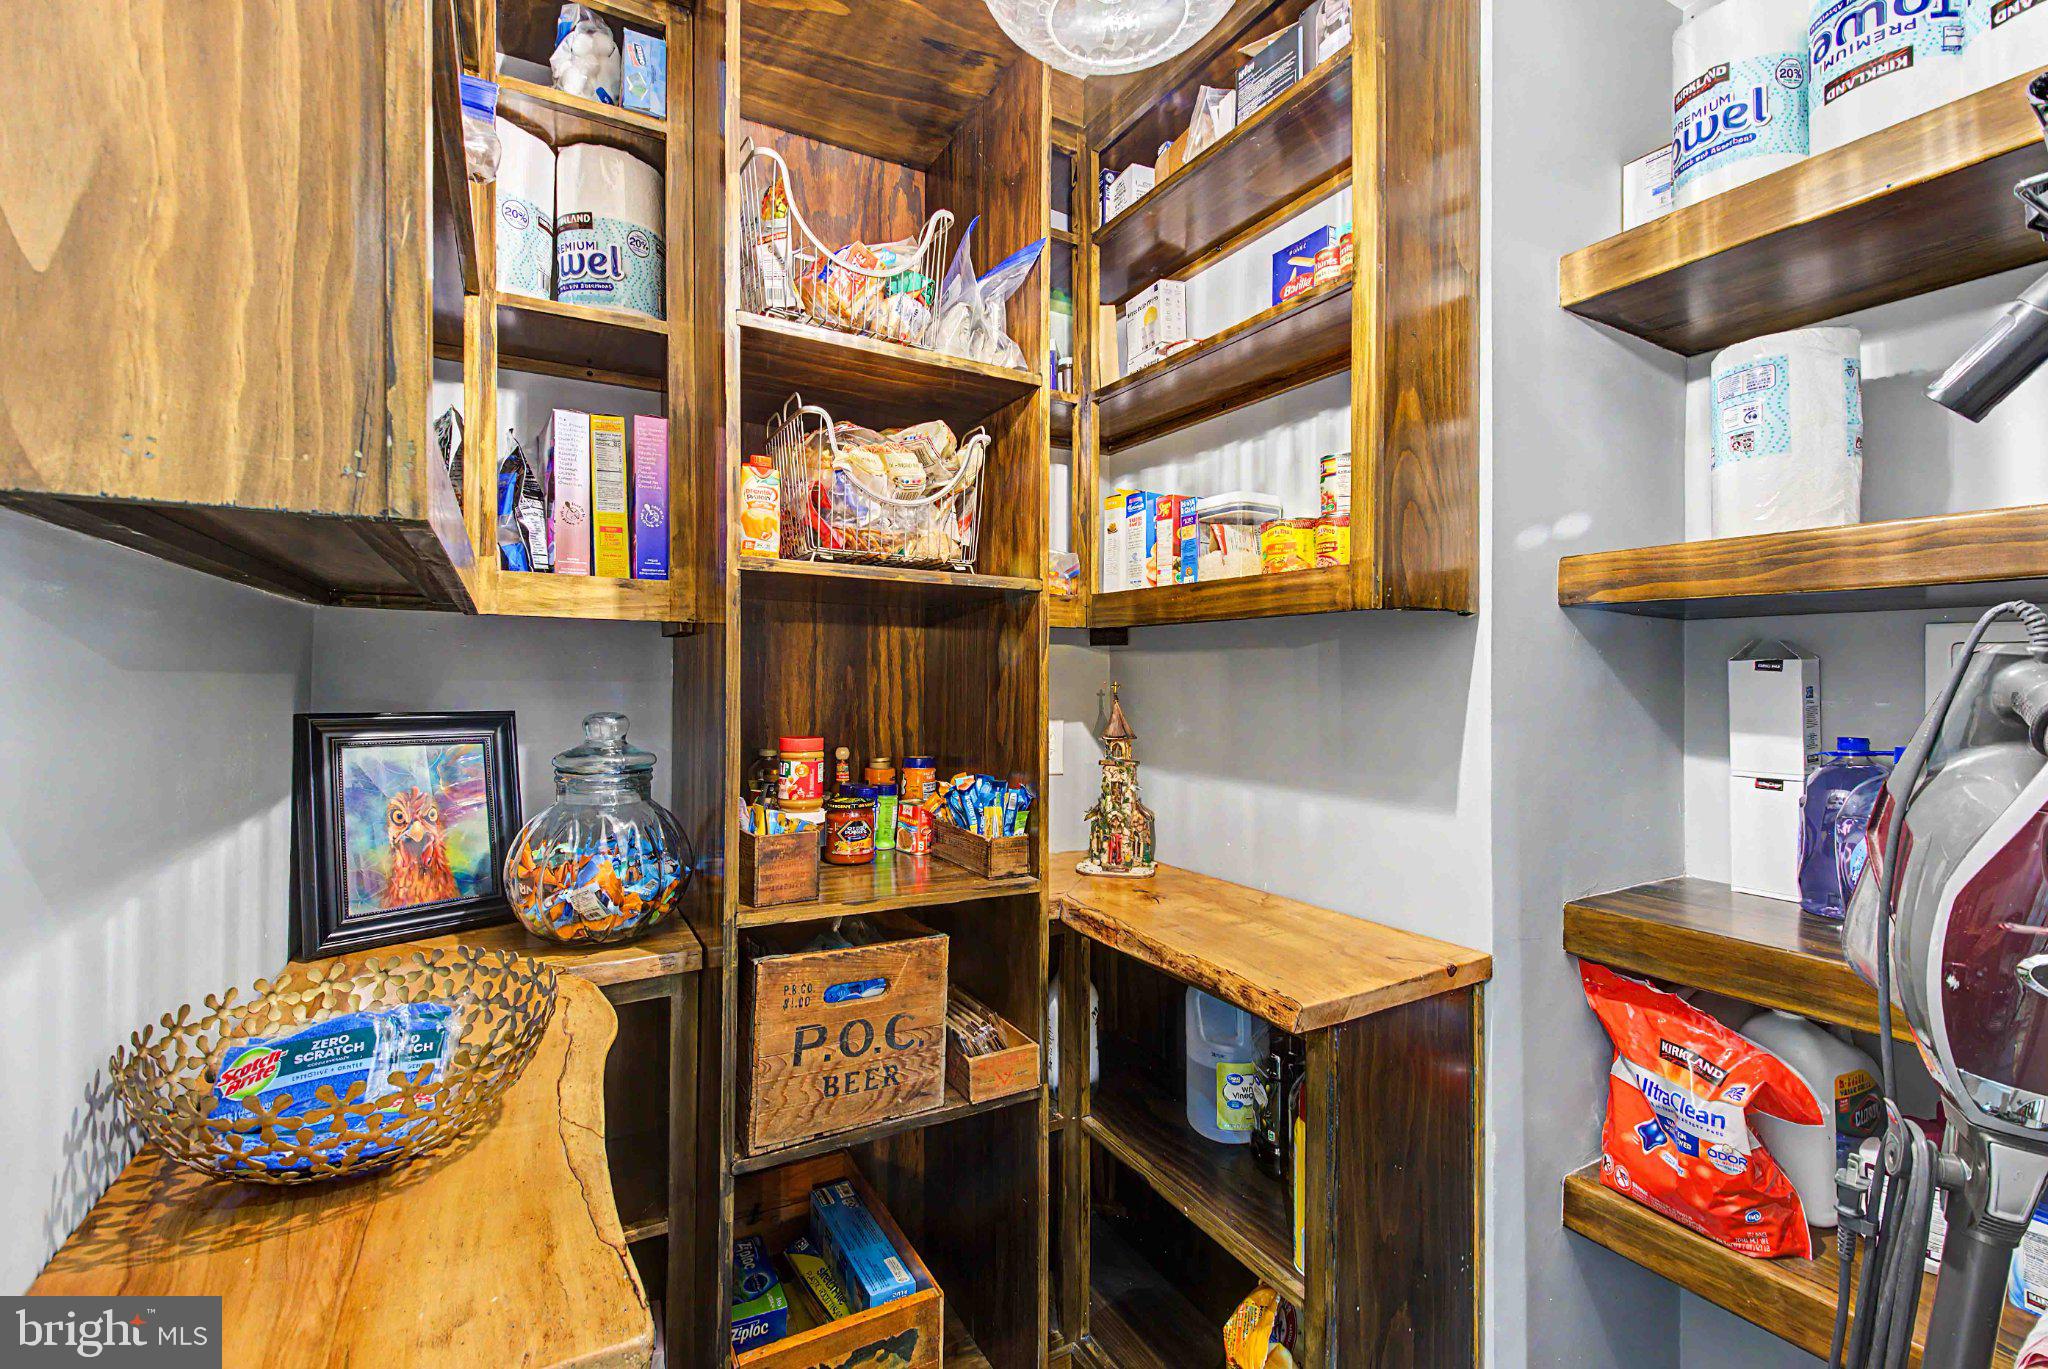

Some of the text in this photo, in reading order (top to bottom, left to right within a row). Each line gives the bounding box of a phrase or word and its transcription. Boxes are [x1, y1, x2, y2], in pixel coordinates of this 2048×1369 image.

[1824, 18, 1916, 72] PREMIUM
[1780, 69, 1801, 78] 20%
[1826, 55, 1909, 100] KIRKLAND
[1672, 87, 1767, 164] owel
[505, 207, 527, 223] 20%
[629, 237, 649, 250] 20%
[312, 1034, 350, 1050] ZERO
[294, 1042, 365, 1064] SCRATCH
[823, 1065, 899, 1098] BEER
[1707, 1148, 1748, 1167] ODOR
